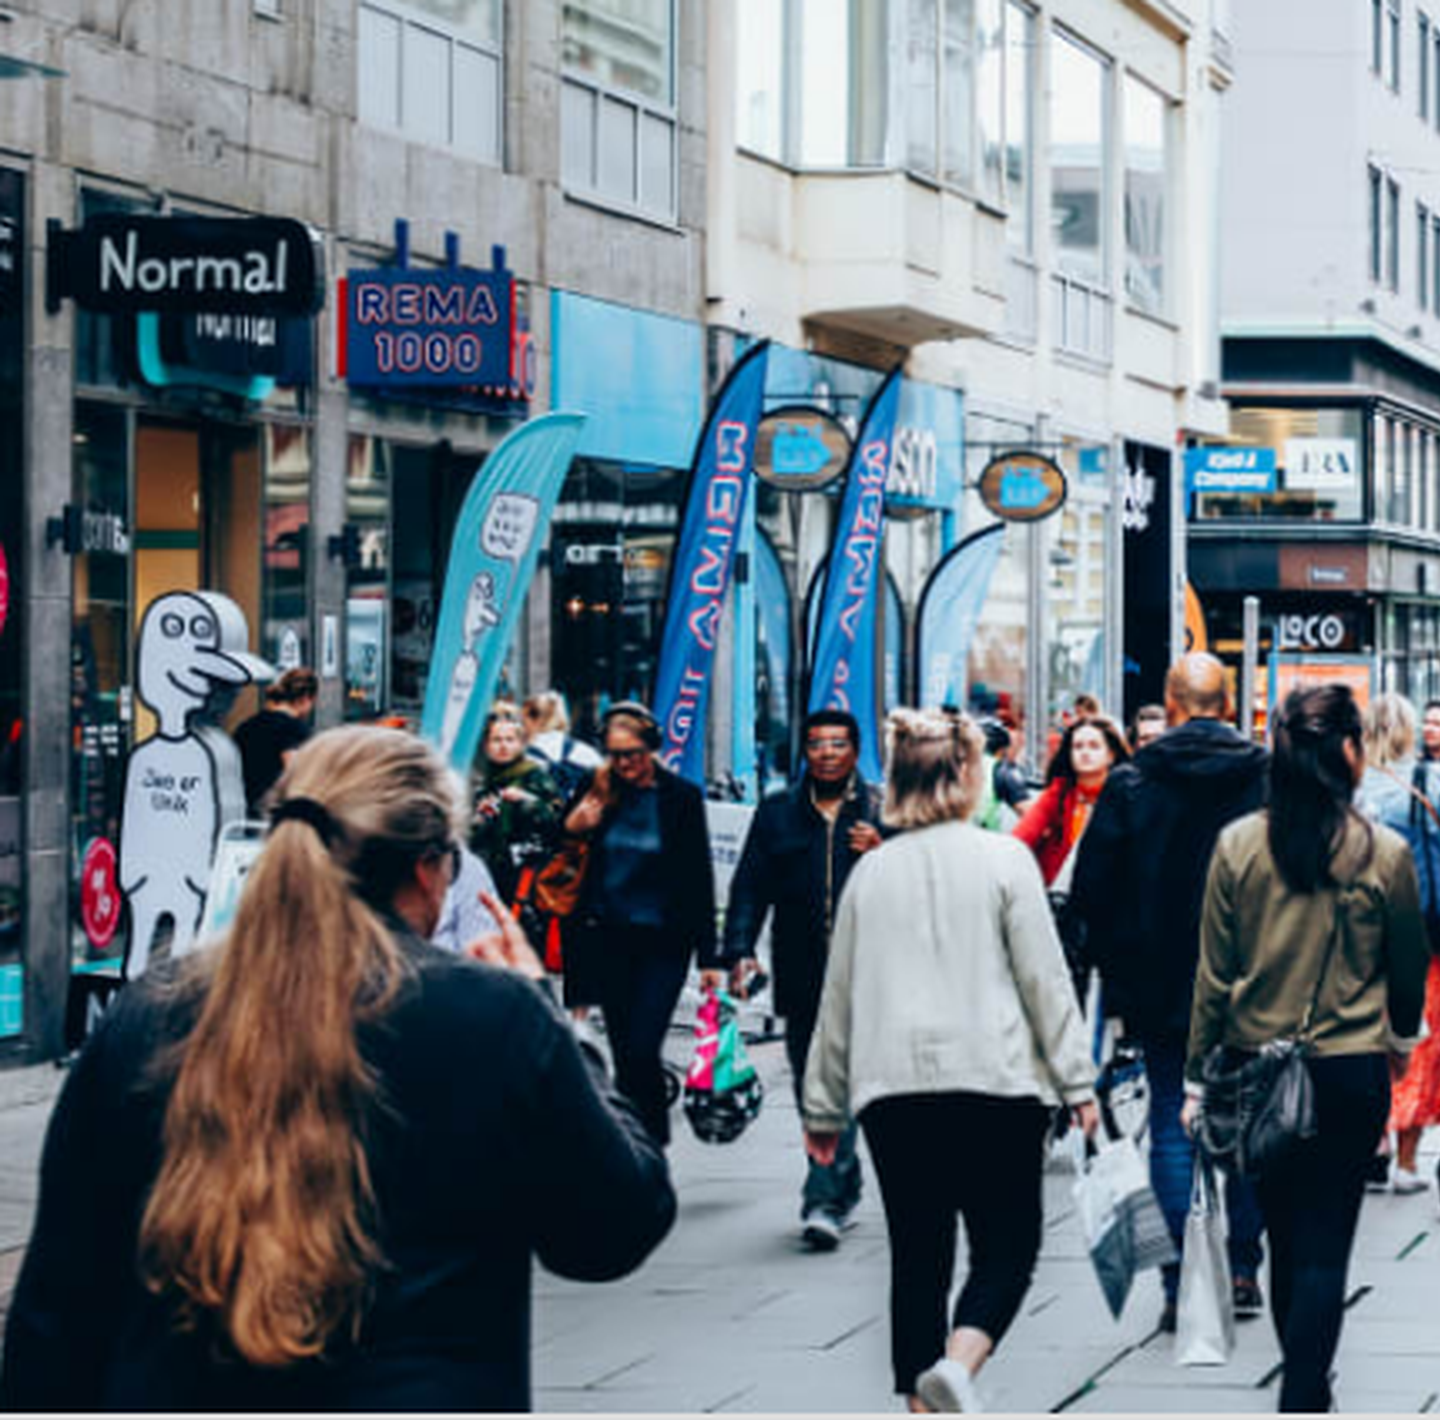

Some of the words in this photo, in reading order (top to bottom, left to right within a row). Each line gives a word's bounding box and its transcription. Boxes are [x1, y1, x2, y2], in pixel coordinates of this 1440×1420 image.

[101, 230, 288, 294] Normal
[357, 283, 498, 324] REMA
[375, 330, 482, 373] 1000
[1279, 614, 1344, 648] LOCO
